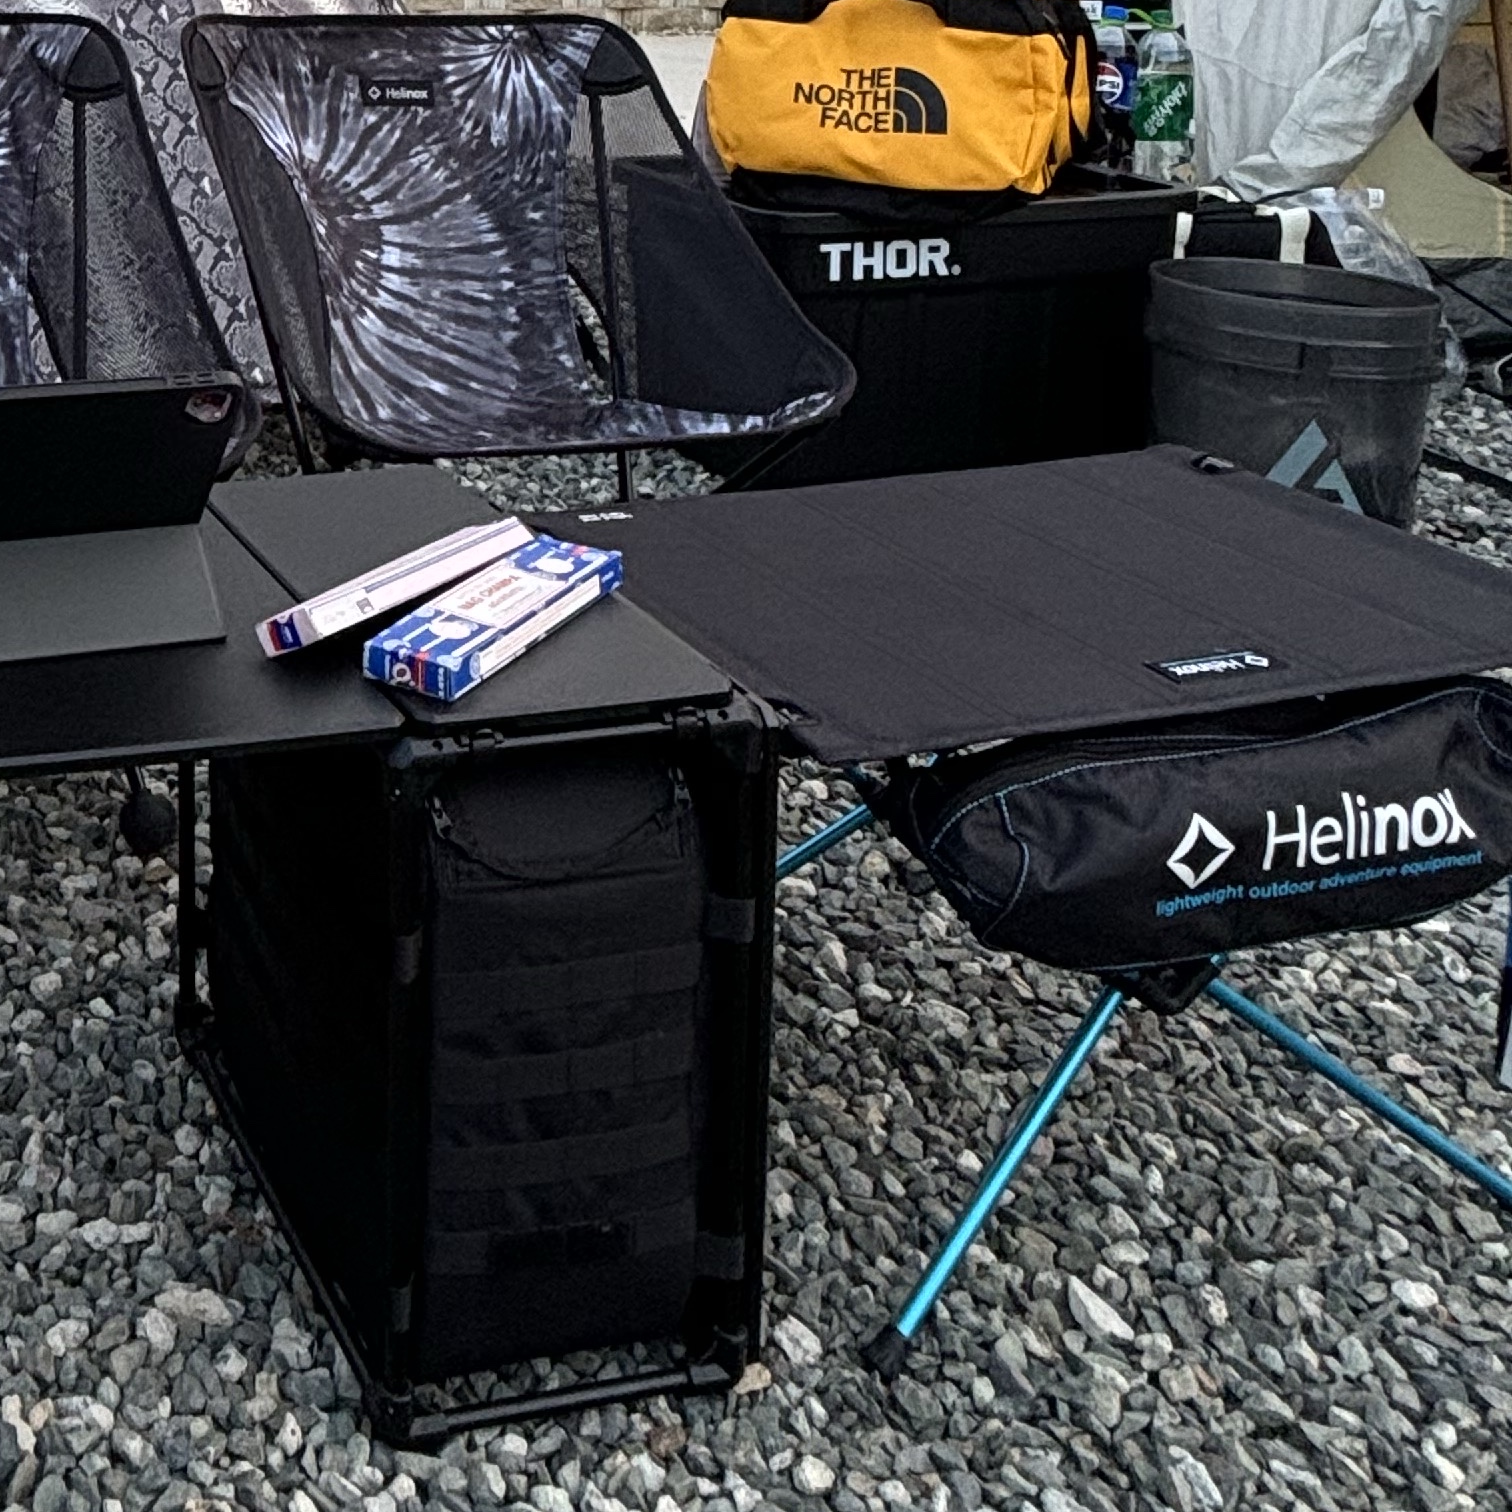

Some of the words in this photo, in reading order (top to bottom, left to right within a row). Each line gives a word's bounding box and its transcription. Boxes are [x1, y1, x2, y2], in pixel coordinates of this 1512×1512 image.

[386, 86, 429, 100] Helinox
[840, 67, 893, 90] THE
[793, 82, 891, 111] NORTH
[819, 106, 891, 134] FACE
[819, 238, 962, 282] THOR.
[1261, 788, 1478, 871] Helinox
[1156, 879, 1244, 918] lightweight
[1248, 878, 1317, 900] outdoor
[1318, 864, 1397, 890] adventure
[1399, 850, 1484, 876] equipment
